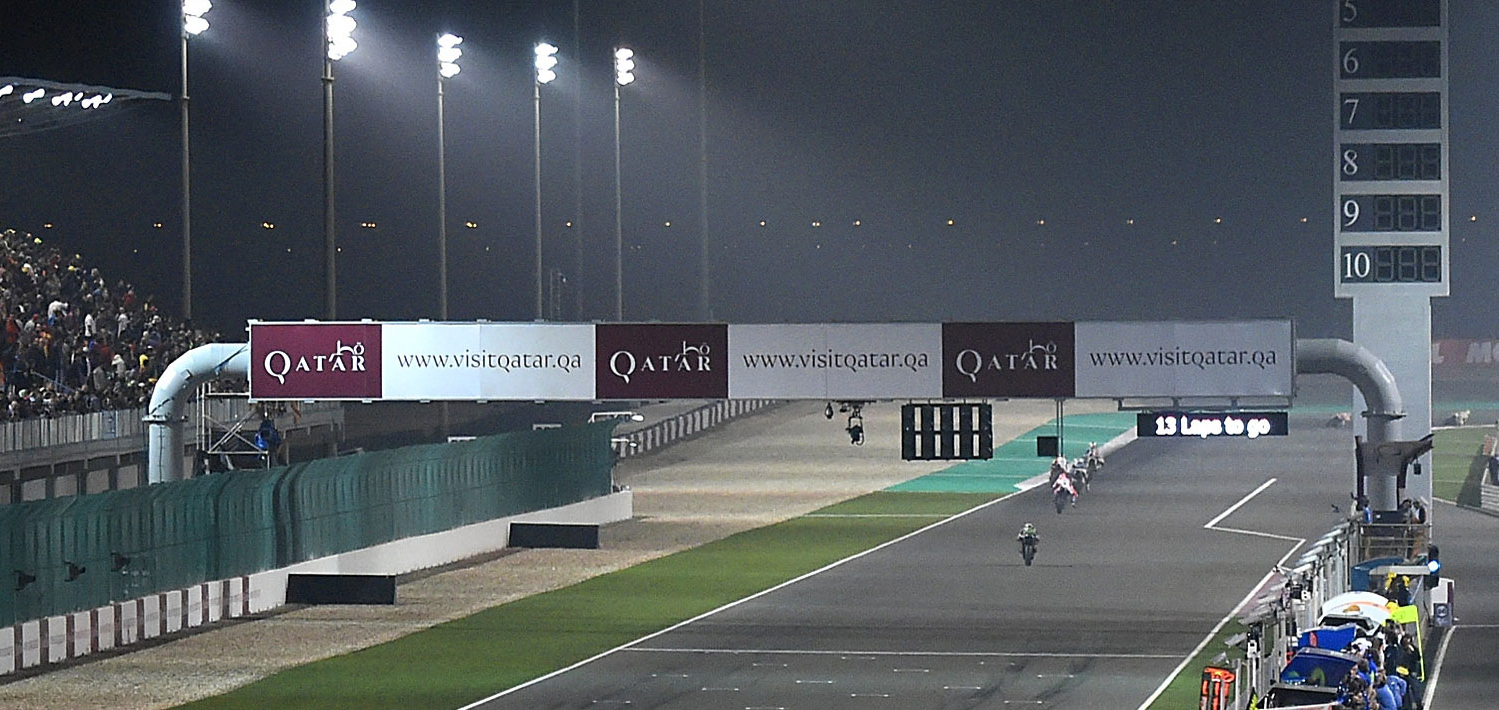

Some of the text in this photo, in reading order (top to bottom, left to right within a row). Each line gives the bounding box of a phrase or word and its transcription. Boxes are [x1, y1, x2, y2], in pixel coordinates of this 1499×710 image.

[1343, 0, 1357, 22] 5
[1343, 48, 1359, 74] 6
[1344, 99, 1359, 124] 7
[1343, 149, 1358, 175] 8
[1343, 200, 1360, 227] 9
[1344, 252, 1371, 278] 10
[264, 350, 366, 385] QATAR
[397, 349, 582, 373] www.visitqatar.qa
[609, 350, 711, 384] QATAR
[742, 348, 929, 372] www.visitqatar.qa
[956, 349, 1057, 382] QATAR
[1089, 346, 1277, 370] www.visitqatar.qa
[1155, 414, 1271, 439] 13 Laps to go
